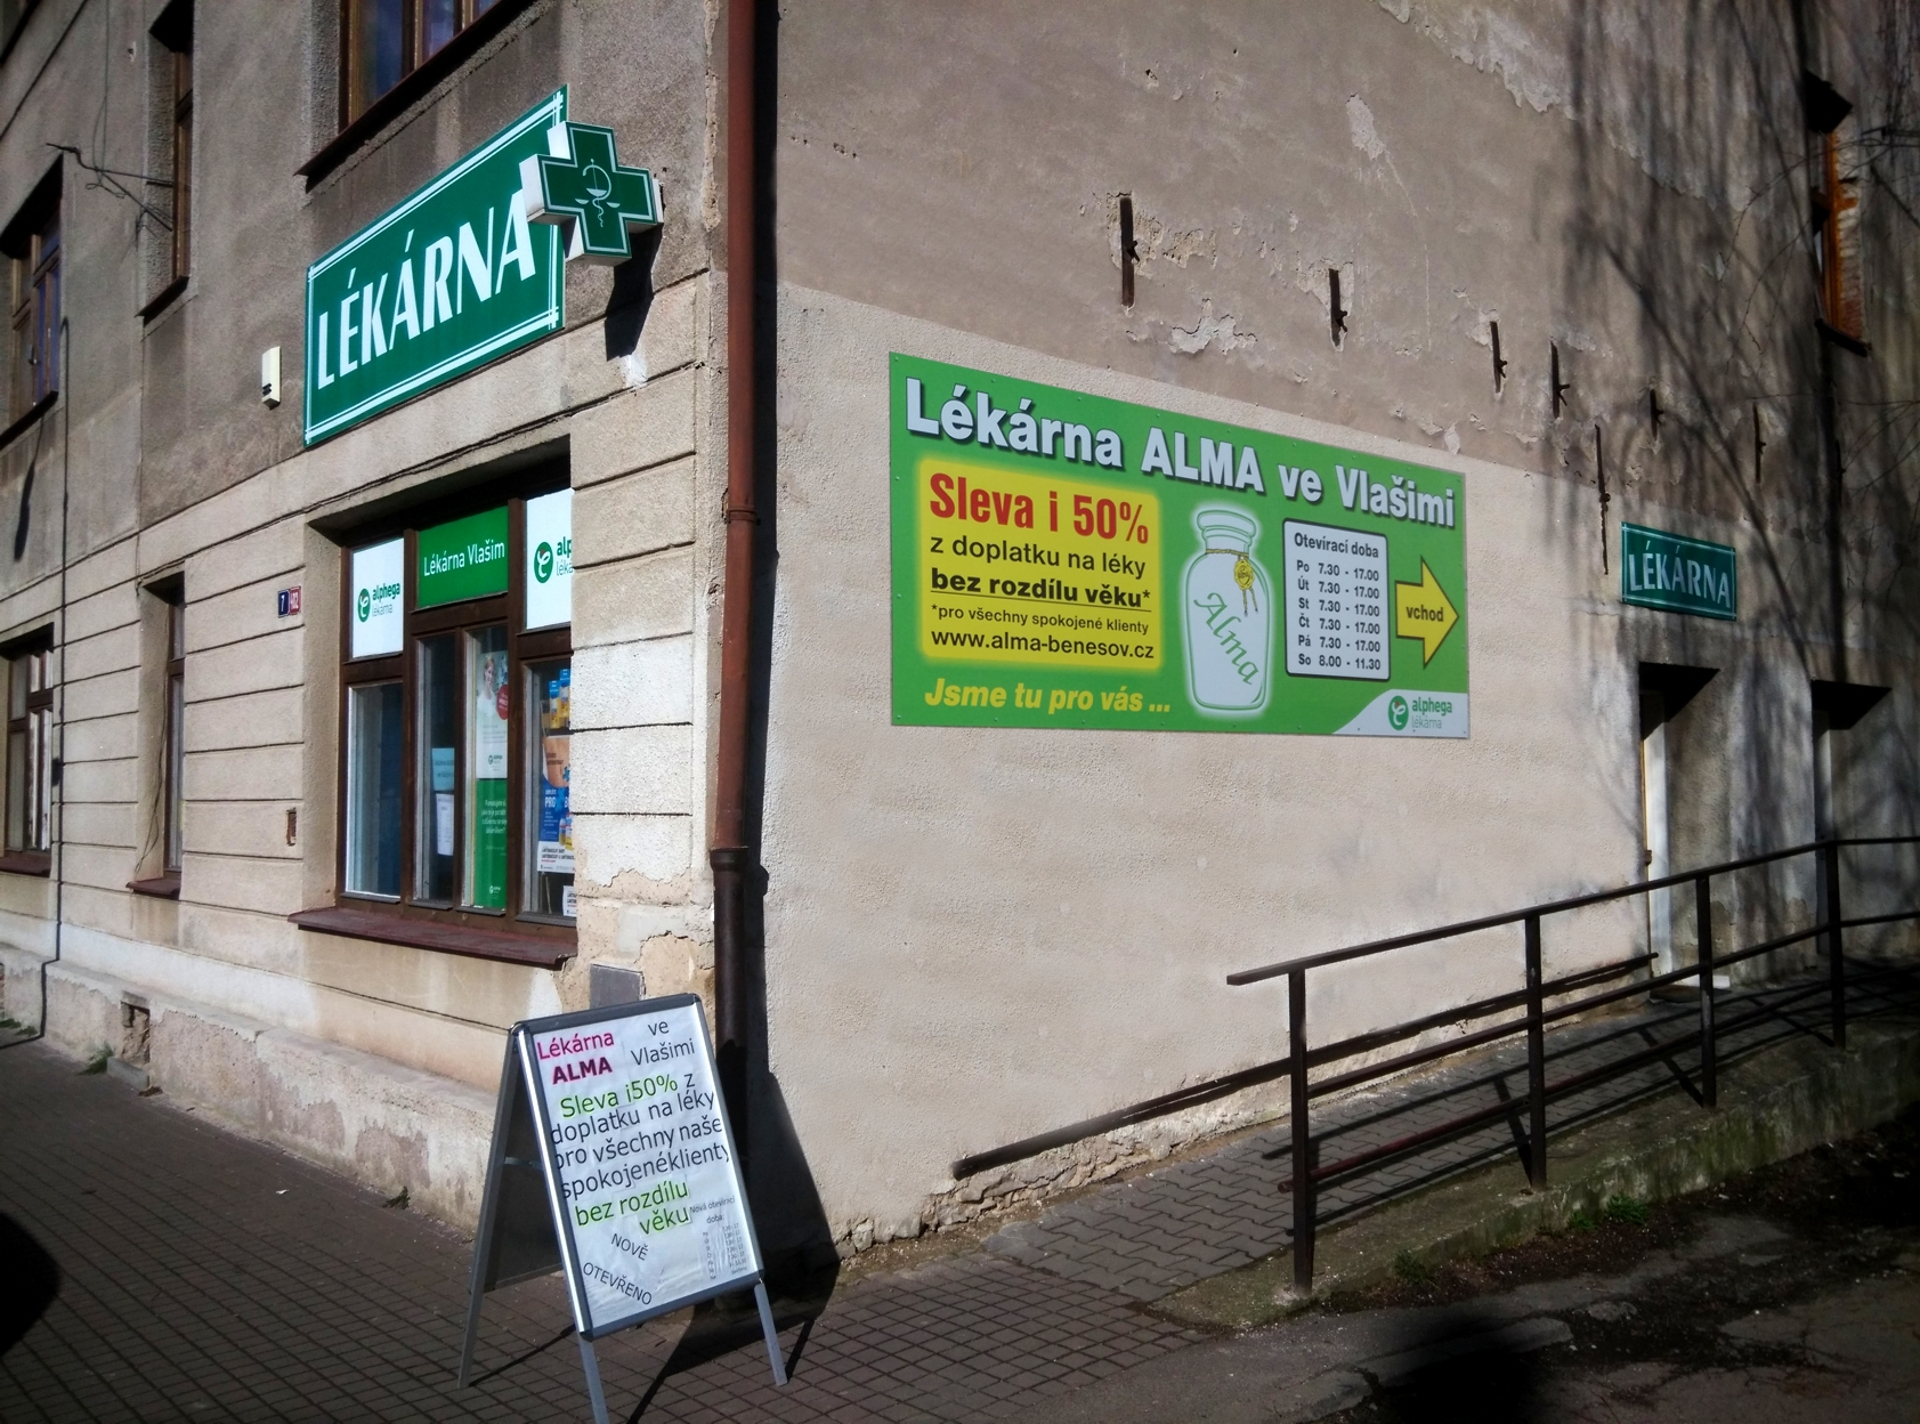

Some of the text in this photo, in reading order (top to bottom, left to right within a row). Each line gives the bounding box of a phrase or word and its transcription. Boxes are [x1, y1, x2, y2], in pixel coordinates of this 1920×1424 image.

[317, 189, 536, 390] LÉKÁRNA
[905, 377, 1455, 528] Lékárna ALMA ve Vlašimi
[930, 472, 1149, 544] Sleva i 50%
[423, 539, 505, 577] Lékárna Vlašim
[930, 535, 1146, 580] z doplatku na léky
[1294, 532, 1379, 558] Otevírací doba
[1296, 559, 1310, 573] Po
[1318, 562, 1340, 577] 7.30
[1353, 568, 1379, 581] 17.00
[1628, 540, 1731, 608] LÉKÁRNA
[931, 568, 981, 593] bez
[989, 577, 1078, 602] rozdílu
[1298, 575, 1309, 591] Út
[1318, 581, 1340, 595] 7.30
[1354, 586, 1380, 599] 17.00
[969, 606, 1028, 626] všechny
[1031, 613, 1103, 631] spokojené
[1106, 618, 1149, 636] klienty
[1298, 597, 1309, 609] St
[1319, 599, 1341, 613] 7.30
[1354, 604, 1380, 617] 17.00
[1405, 604, 1444, 622] vchod
[1194, 592, 1259, 685] Alma
[1298, 613, 1310, 628] Čt
[1319, 617, 1341, 631] 7.30
[1354, 622, 1380, 635] 17.00
[931, 630, 1154, 659] www.alma-benesov.cz
[1298, 634, 1311, 647] Pá
[1319, 636, 1341, 649] 7.30
[1355, 640, 1381, 652] 17.00
[1298, 653, 1311, 665] So
[1319, 654, 1342, 668] 8.00
[1355, 658, 1381, 670] 11.30
[924, 678, 1007, 707] Jsme
[1015, 683, 1041, 708] tu
[1048, 688, 1094, 714] pro
[1102, 686, 1143, 712] vás
[1412, 697, 1453, 716] alphega
[1412, 715, 1442, 729] lékárna
[648, 1020, 670, 1036] ve
[536, 1032, 615, 1060] Lékárna
[630, 1038, 695, 1066] Vlašimi
[552, 1056, 613, 1085] ALMA
[560, 1091, 619, 1118] Sleva
[684, 1073, 696, 1088] z
[551, 1089, 715, 1145] doplatku na léky
[592, 1127, 675, 1162] všechny
[679, 1114, 723, 1142] naše
[575, 1180, 688, 1227] bez rozdílu
[640, 1207, 689, 1235] věku
[610, 1233, 649, 1261] NOVĚ
[583, 1261, 653, 1305] OTEVŘENO
